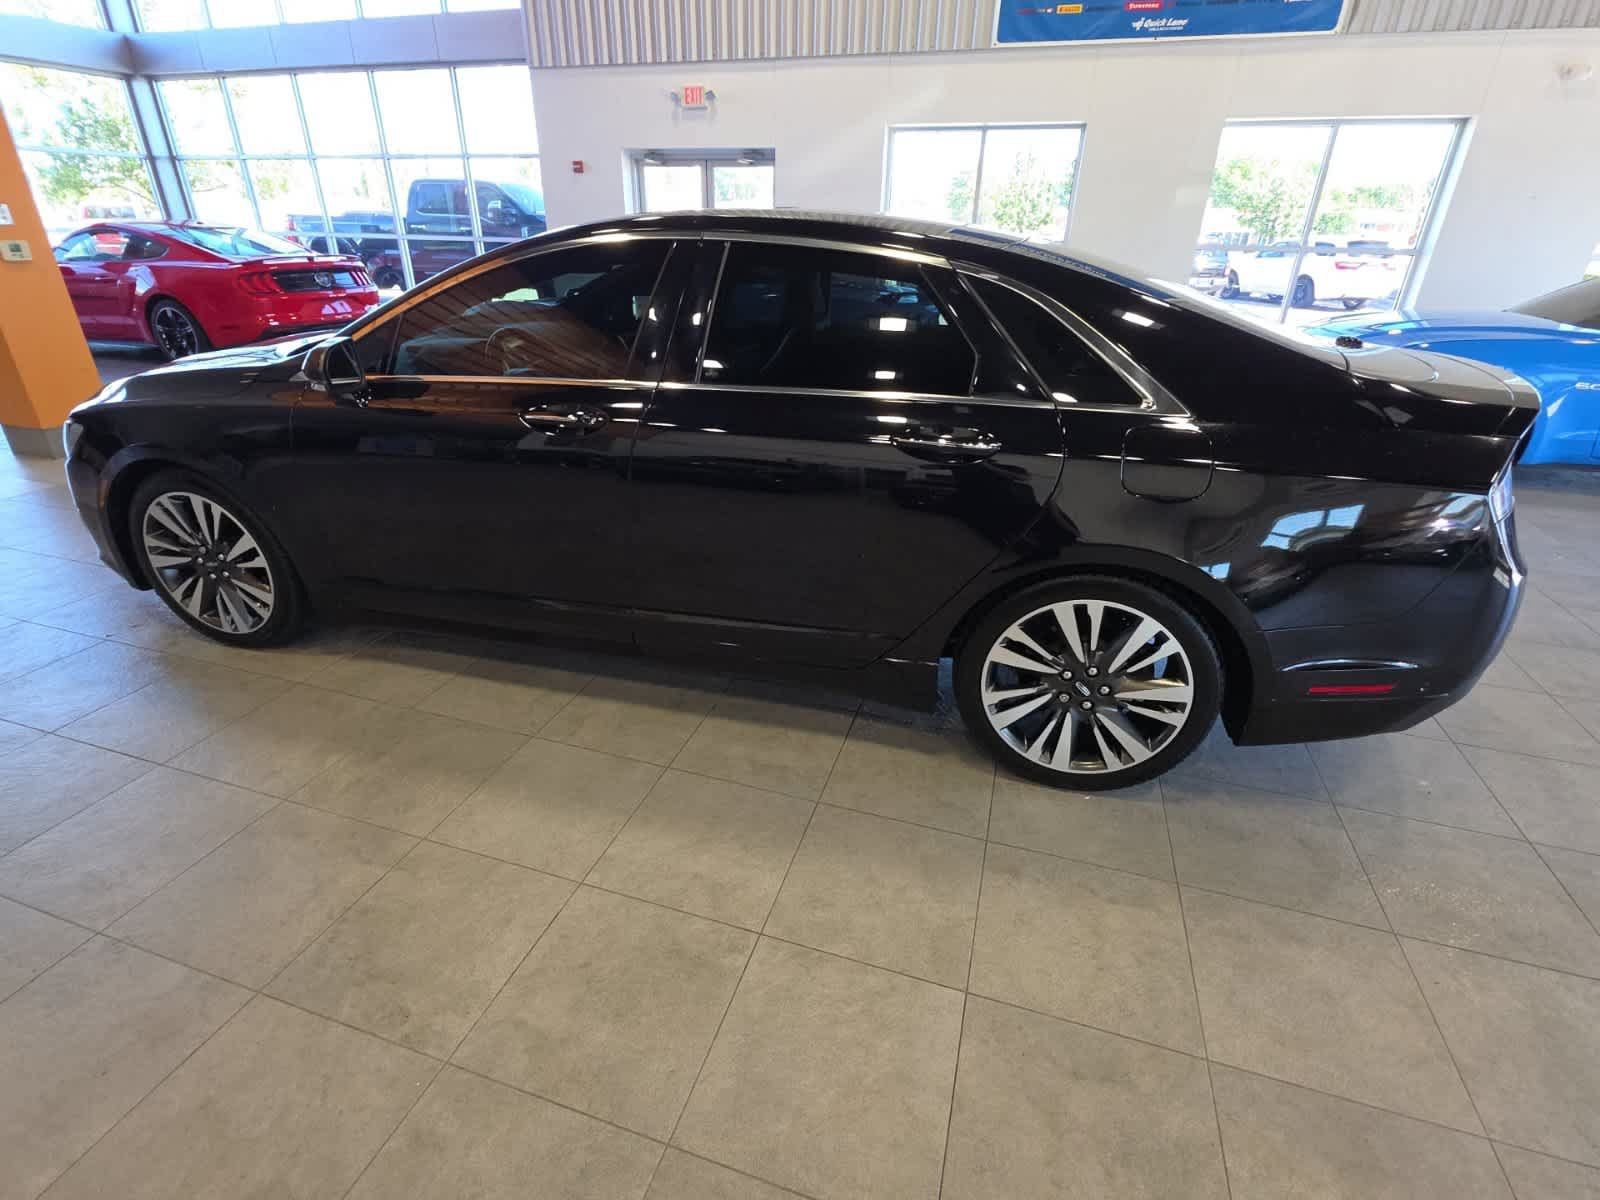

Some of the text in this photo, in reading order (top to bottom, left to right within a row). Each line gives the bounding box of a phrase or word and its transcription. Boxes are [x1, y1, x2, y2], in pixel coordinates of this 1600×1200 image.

[1143, 17, 1189, 28] Quick Lane
[684, 87, 703, 105] EXIT
